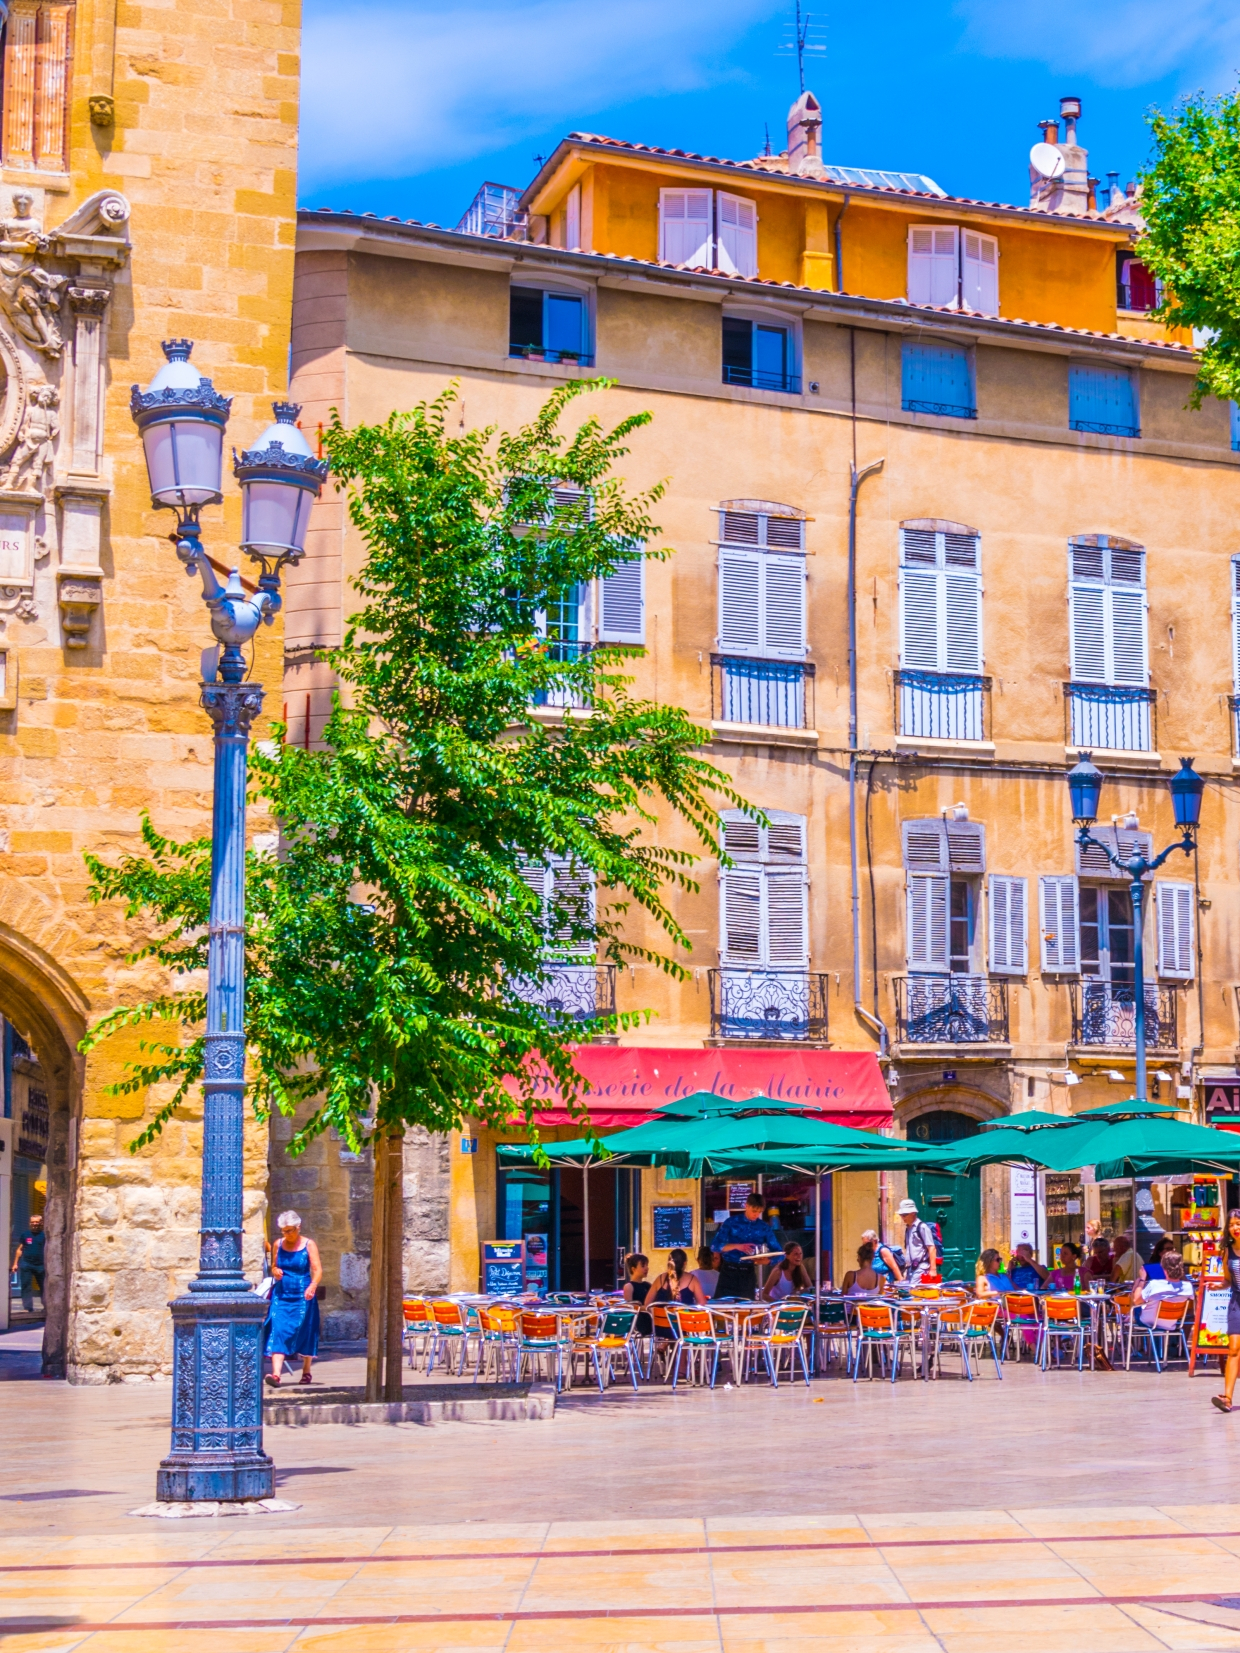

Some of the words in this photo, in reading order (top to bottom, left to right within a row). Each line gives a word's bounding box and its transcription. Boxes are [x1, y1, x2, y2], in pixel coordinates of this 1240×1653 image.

[0, 541, 20, 551] RS
[529, 1068, 653, 1098] Bsserie
[664, 1075, 694, 1098] de
[711, 1071, 738, 1097] la
[749, 1073, 846, 1099] Mairie
